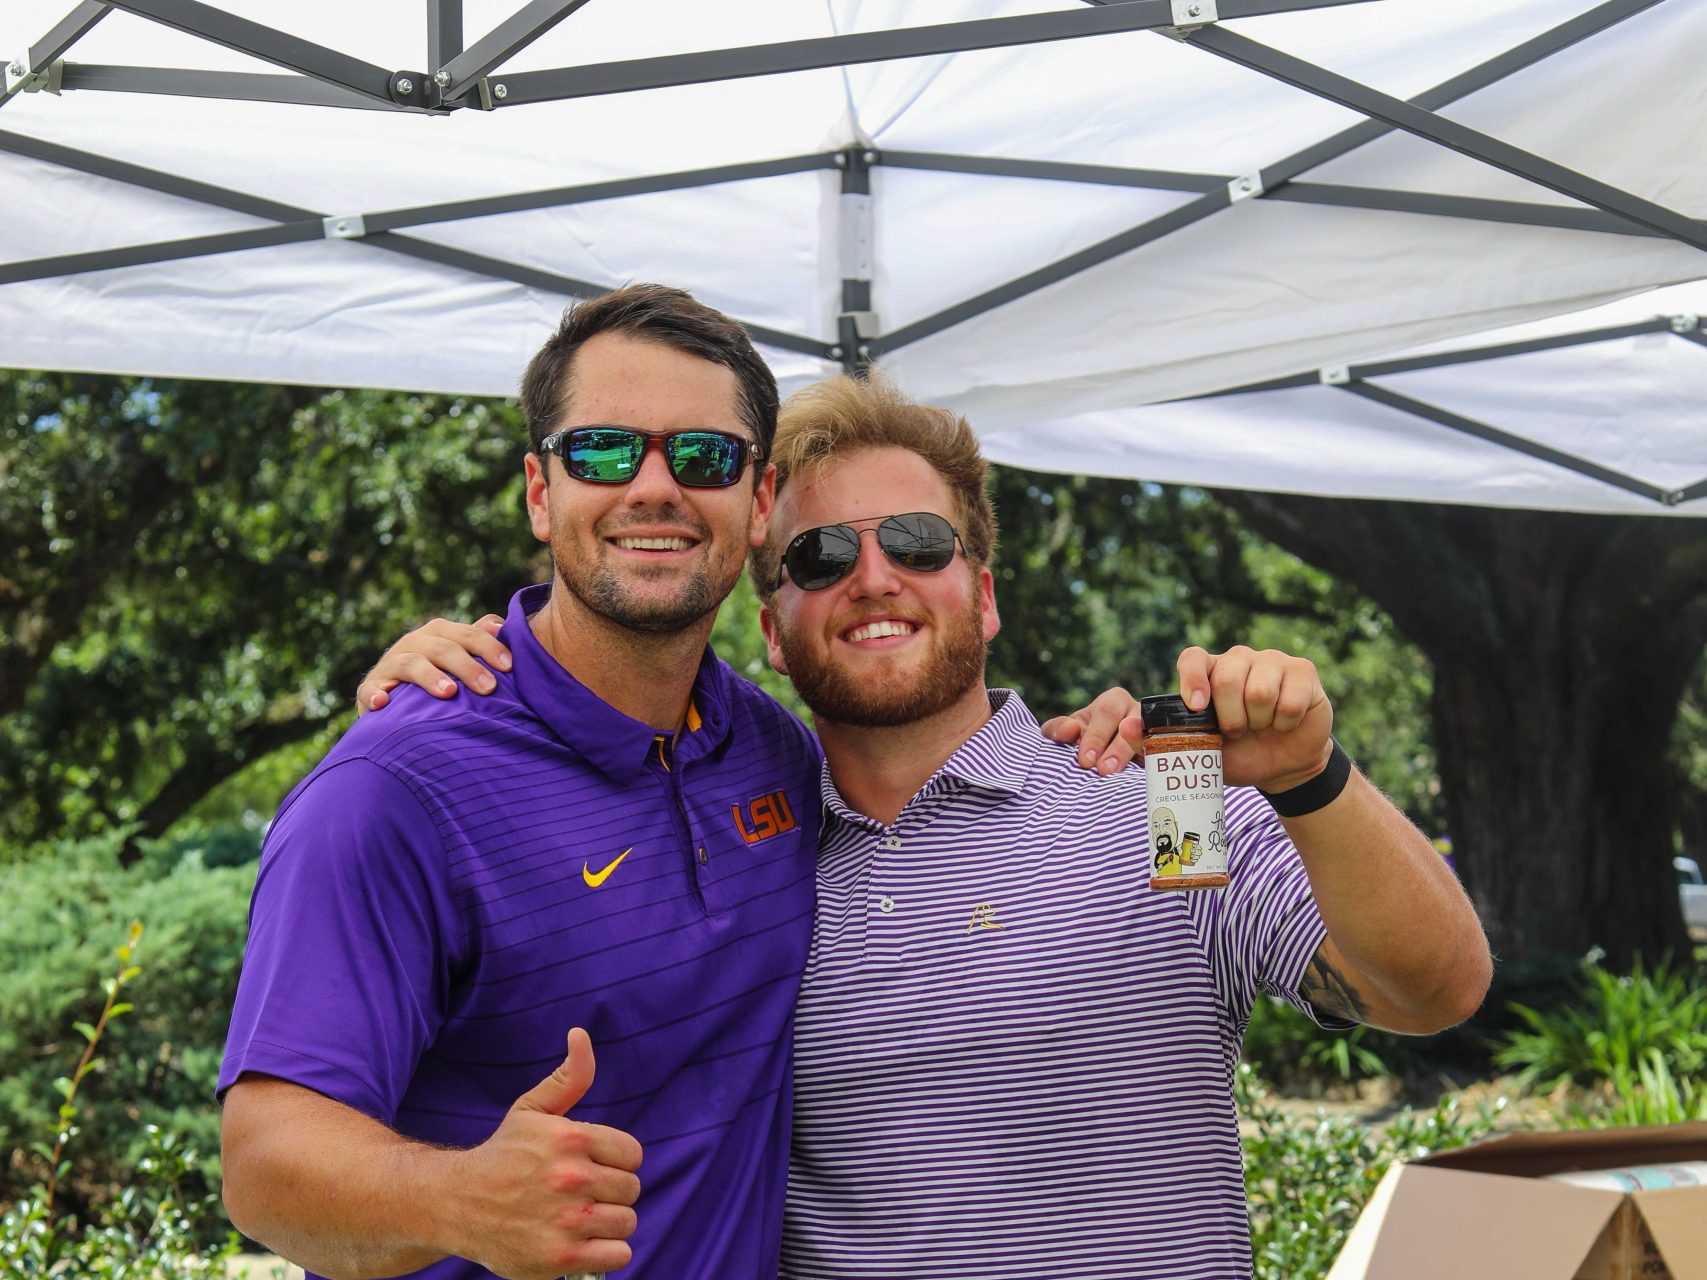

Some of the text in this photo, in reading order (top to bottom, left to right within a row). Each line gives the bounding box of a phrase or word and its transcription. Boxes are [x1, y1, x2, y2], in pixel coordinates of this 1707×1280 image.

[1157, 754, 1222, 773] BAYOU
[1166, 773, 1219, 791] DUST
[731, 790, 797, 845] LSU
